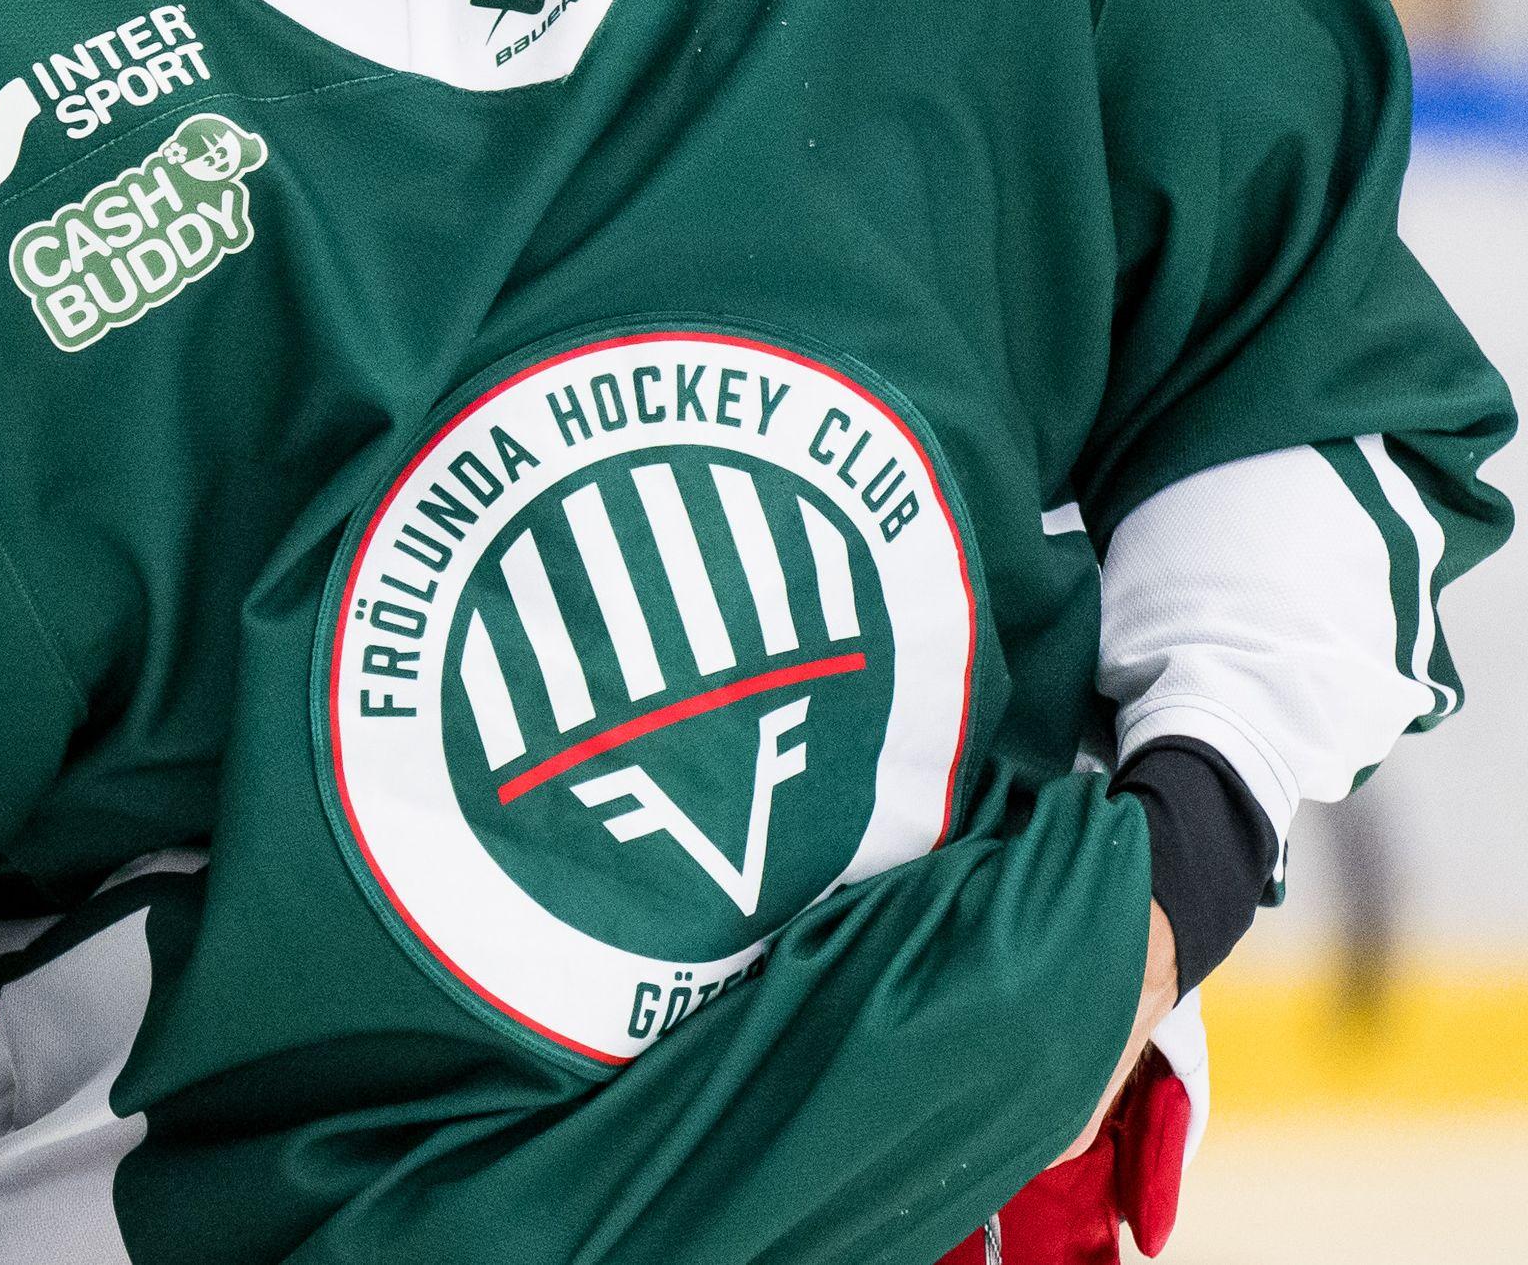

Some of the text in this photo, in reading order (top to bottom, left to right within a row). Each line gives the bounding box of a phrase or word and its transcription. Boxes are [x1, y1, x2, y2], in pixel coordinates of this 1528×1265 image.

[32, 5, 198, 101] INTER
[55, 42, 212, 139] SPORT
[22, 167, 182, 288] CASH
[46, 191, 240, 339] BUDDY
[354, 363, 921, 718] FRÖLUNDA HOCKEY CLUB
